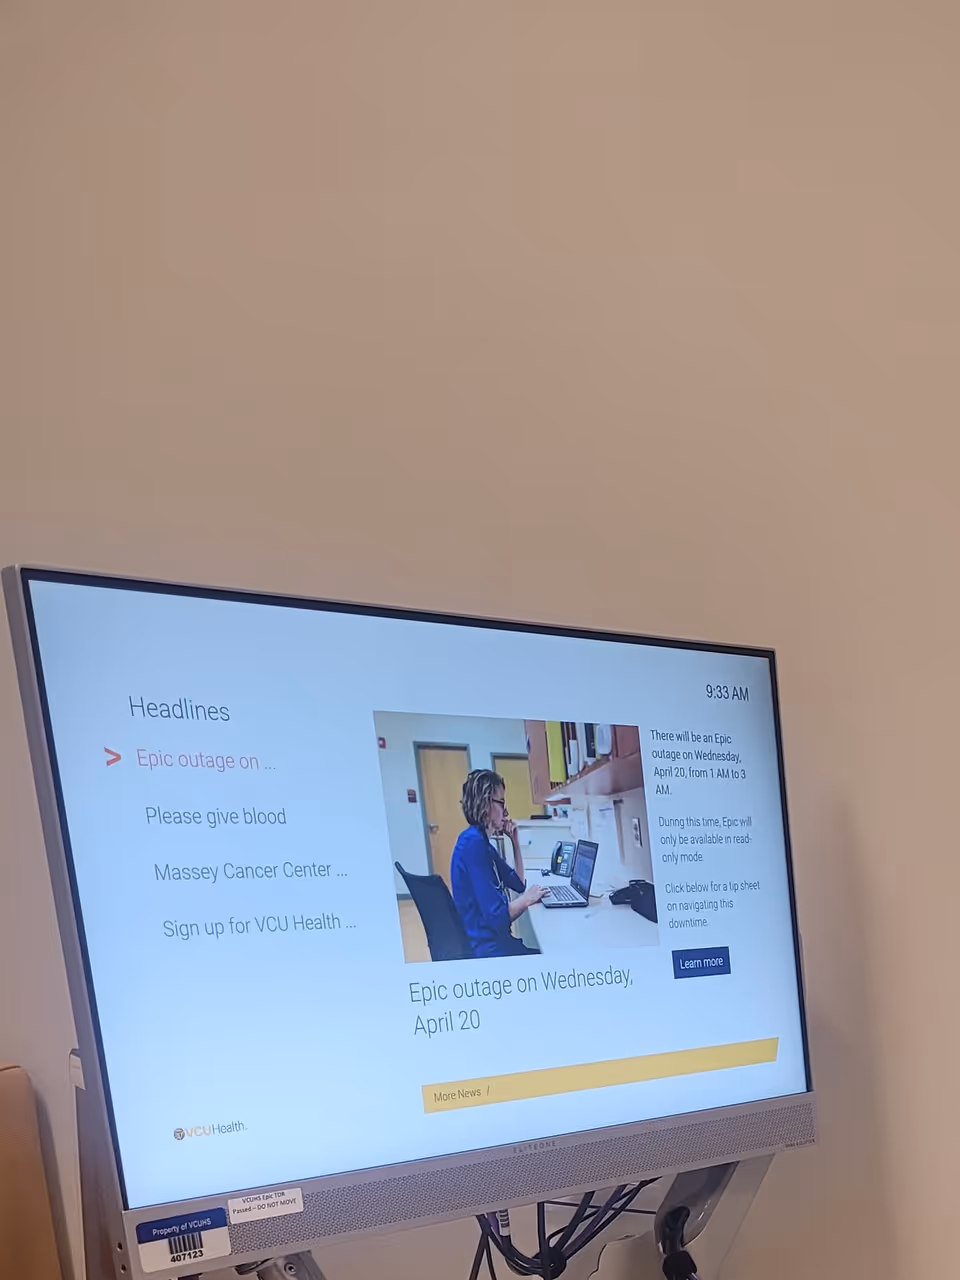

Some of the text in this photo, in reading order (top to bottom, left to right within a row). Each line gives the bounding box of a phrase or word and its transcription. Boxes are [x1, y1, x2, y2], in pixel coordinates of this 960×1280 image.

[705, 684, 749, 701] 9:33 AM
[129, 696, 231, 721] Headlines
[650, 729, 732, 746] There will be an Epic
[136, 749, 173, 770] Epic
[178, 752, 235, 772] outage
[239, 755, 259, 769] on
[652, 749, 742, 764] outage on Wednesday,
[654, 766, 672, 779] April
[674, 767, 687, 779] 20,
[689, 766, 708, 778] from
[716, 768, 730, 779] AM
[731, 769, 739, 779] to
[741, 769, 747, 779] 3
[655, 784, 672, 795] AM.
[145, 806, 287, 828] Please give blood
[659, 816, 752, 829] During this time, Epic will
[660, 833, 752, 847] only be available in read-
[662, 852, 679, 865] only
[154, 863, 219, 884] Massey
[223, 862, 279, 880] Cancer
[283, 861, 331, 878] Center
[665, 882, 685, 893] Click
[686, 881, 709, 892] below
[710, 881, 722, 892] for
[729, 881, 739, 893] tip
[740, 880, 760, 891] sheet
[667, 898, 734, 912] on navigating this
[163, 919, 202, 940] Sign
[205, 923, 224, 939] up
[229, 916, 251, 934] for
[255, 915, 289, 933] VCU
[293, 912, 341, 931] Health
[680, 957, 724, 970] Learn more
[409, 965, 634, 1006] Epic outage on Wednesday,
[413, 1009, 481, 1038] April 20
[433, 1090, 457, 1103] More
[457, 1087, 482, 1099] News
[232, 1204, 252, 1215] Passed
[257, 1203, 267, 1211] DO
[267, 1200, 280, 1209] NOT
[280, 1197, 297, 1207] MOVE
[242, 1194, 261, 1204] VCUHS
[152, 1217, 212, 1237] Property of VCUHS
[170, 1249, 204, 1264] 407123
